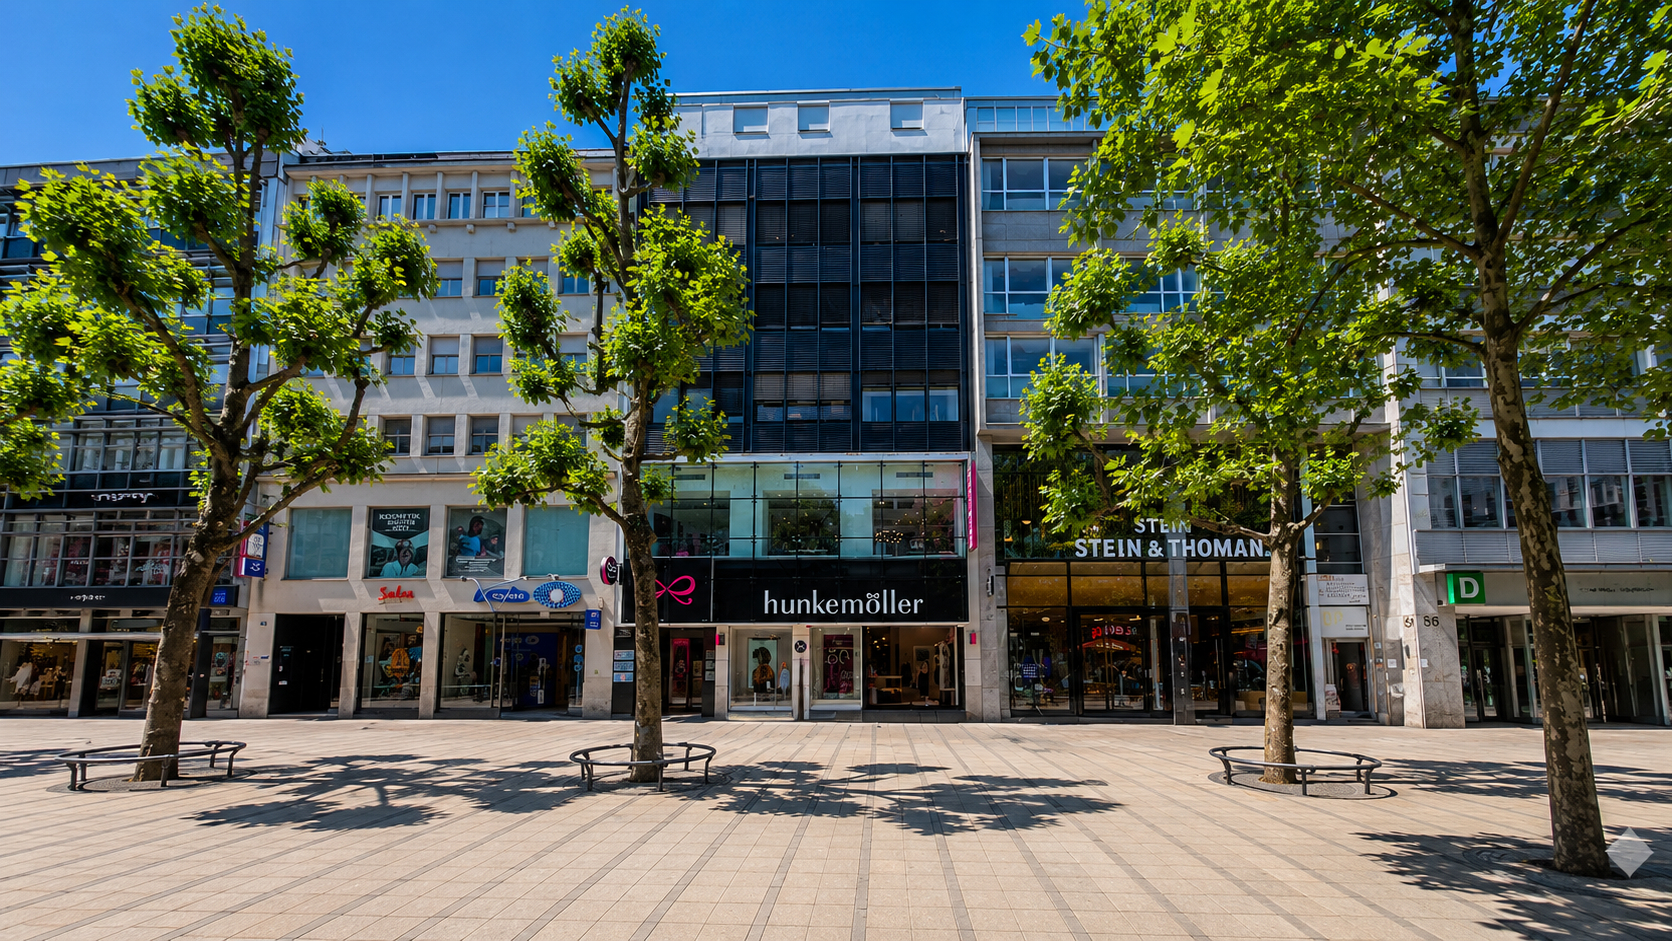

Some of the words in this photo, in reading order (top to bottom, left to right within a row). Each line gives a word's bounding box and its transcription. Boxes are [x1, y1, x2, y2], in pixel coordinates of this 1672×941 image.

[1134, 518, 1191, 534] STEIN
[1074, 538, 1142, 558] STEIN
[1147, 539, 1165, 558] &
[1459, 577, 1480, 599] D
[763, 589, 925, 615] hunkemöller
